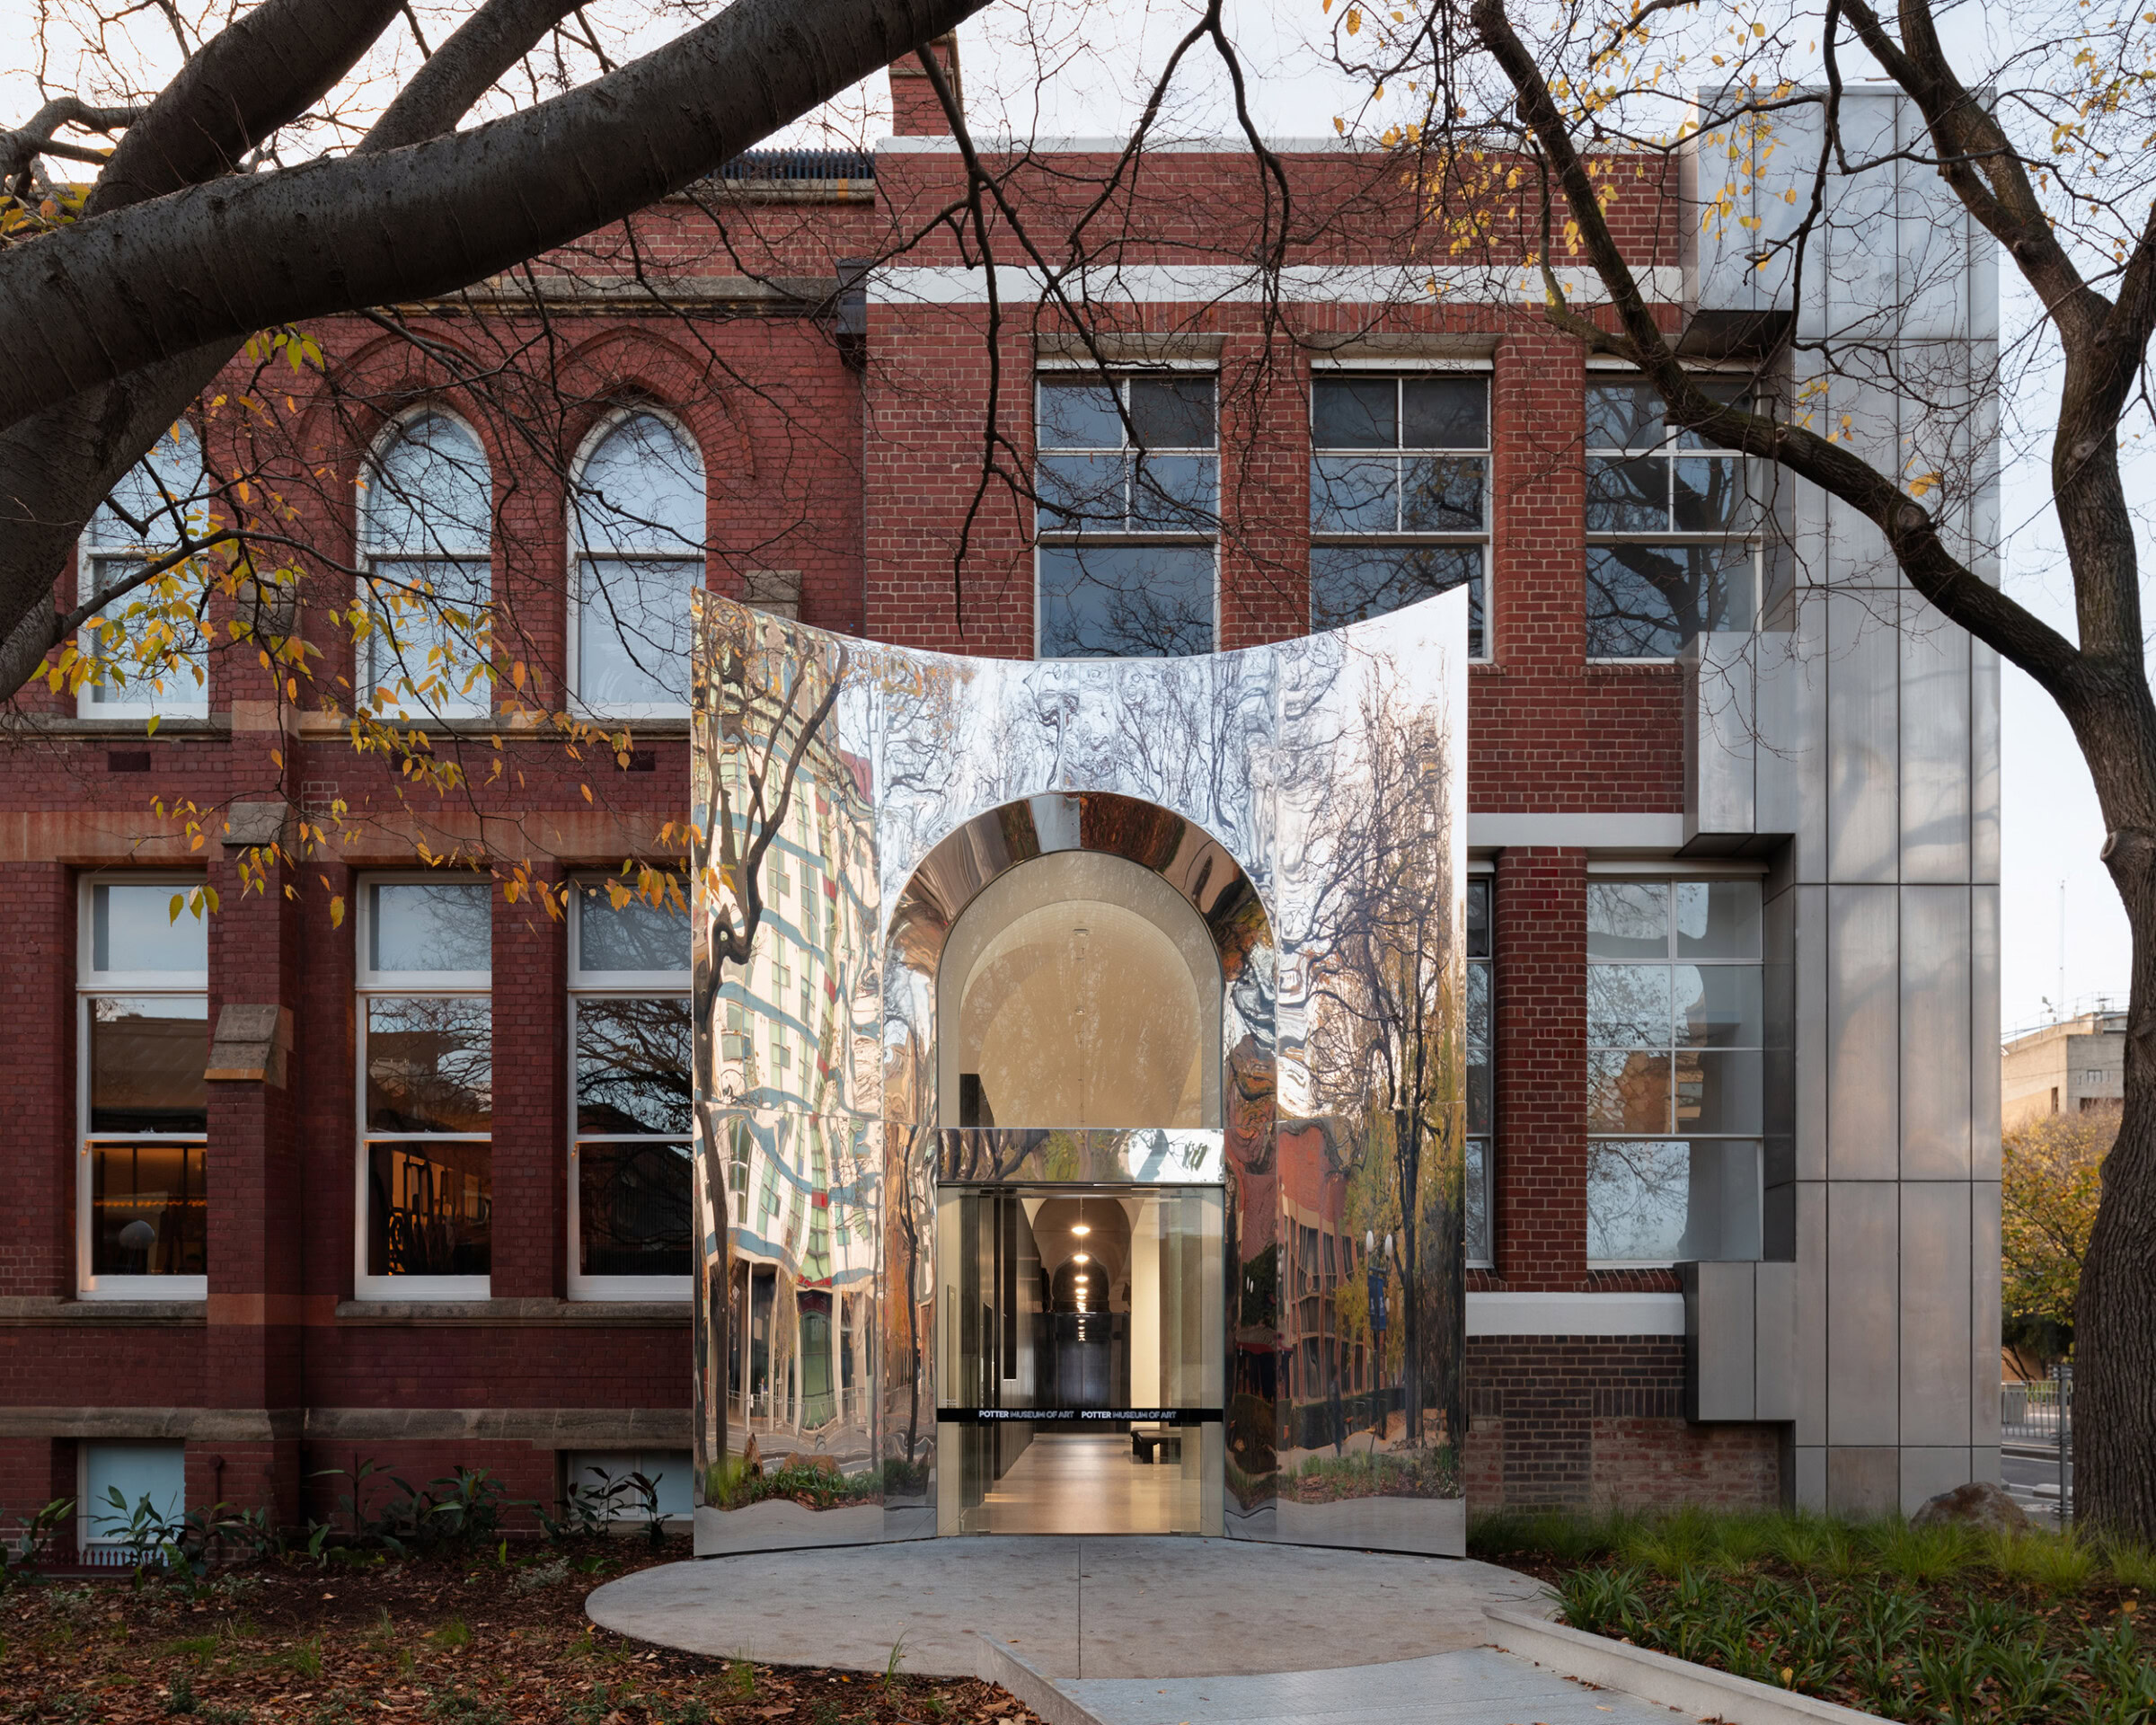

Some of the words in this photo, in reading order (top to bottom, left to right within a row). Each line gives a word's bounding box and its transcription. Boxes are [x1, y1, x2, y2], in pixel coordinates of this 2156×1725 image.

[978, 1410, 1009, 1418] POTTER
[1010, 1411, 1046, 1419] MUSEUM
[1046, 1411, 1057, 1419] OF
[1058, 1411, 1074, 1419] ART
[1081, 1411, 1111, 1419] POTTER
[1112, 1411, 1148, 1419] MUSEUM
[1160, 1411, 1177, 1419] ART
